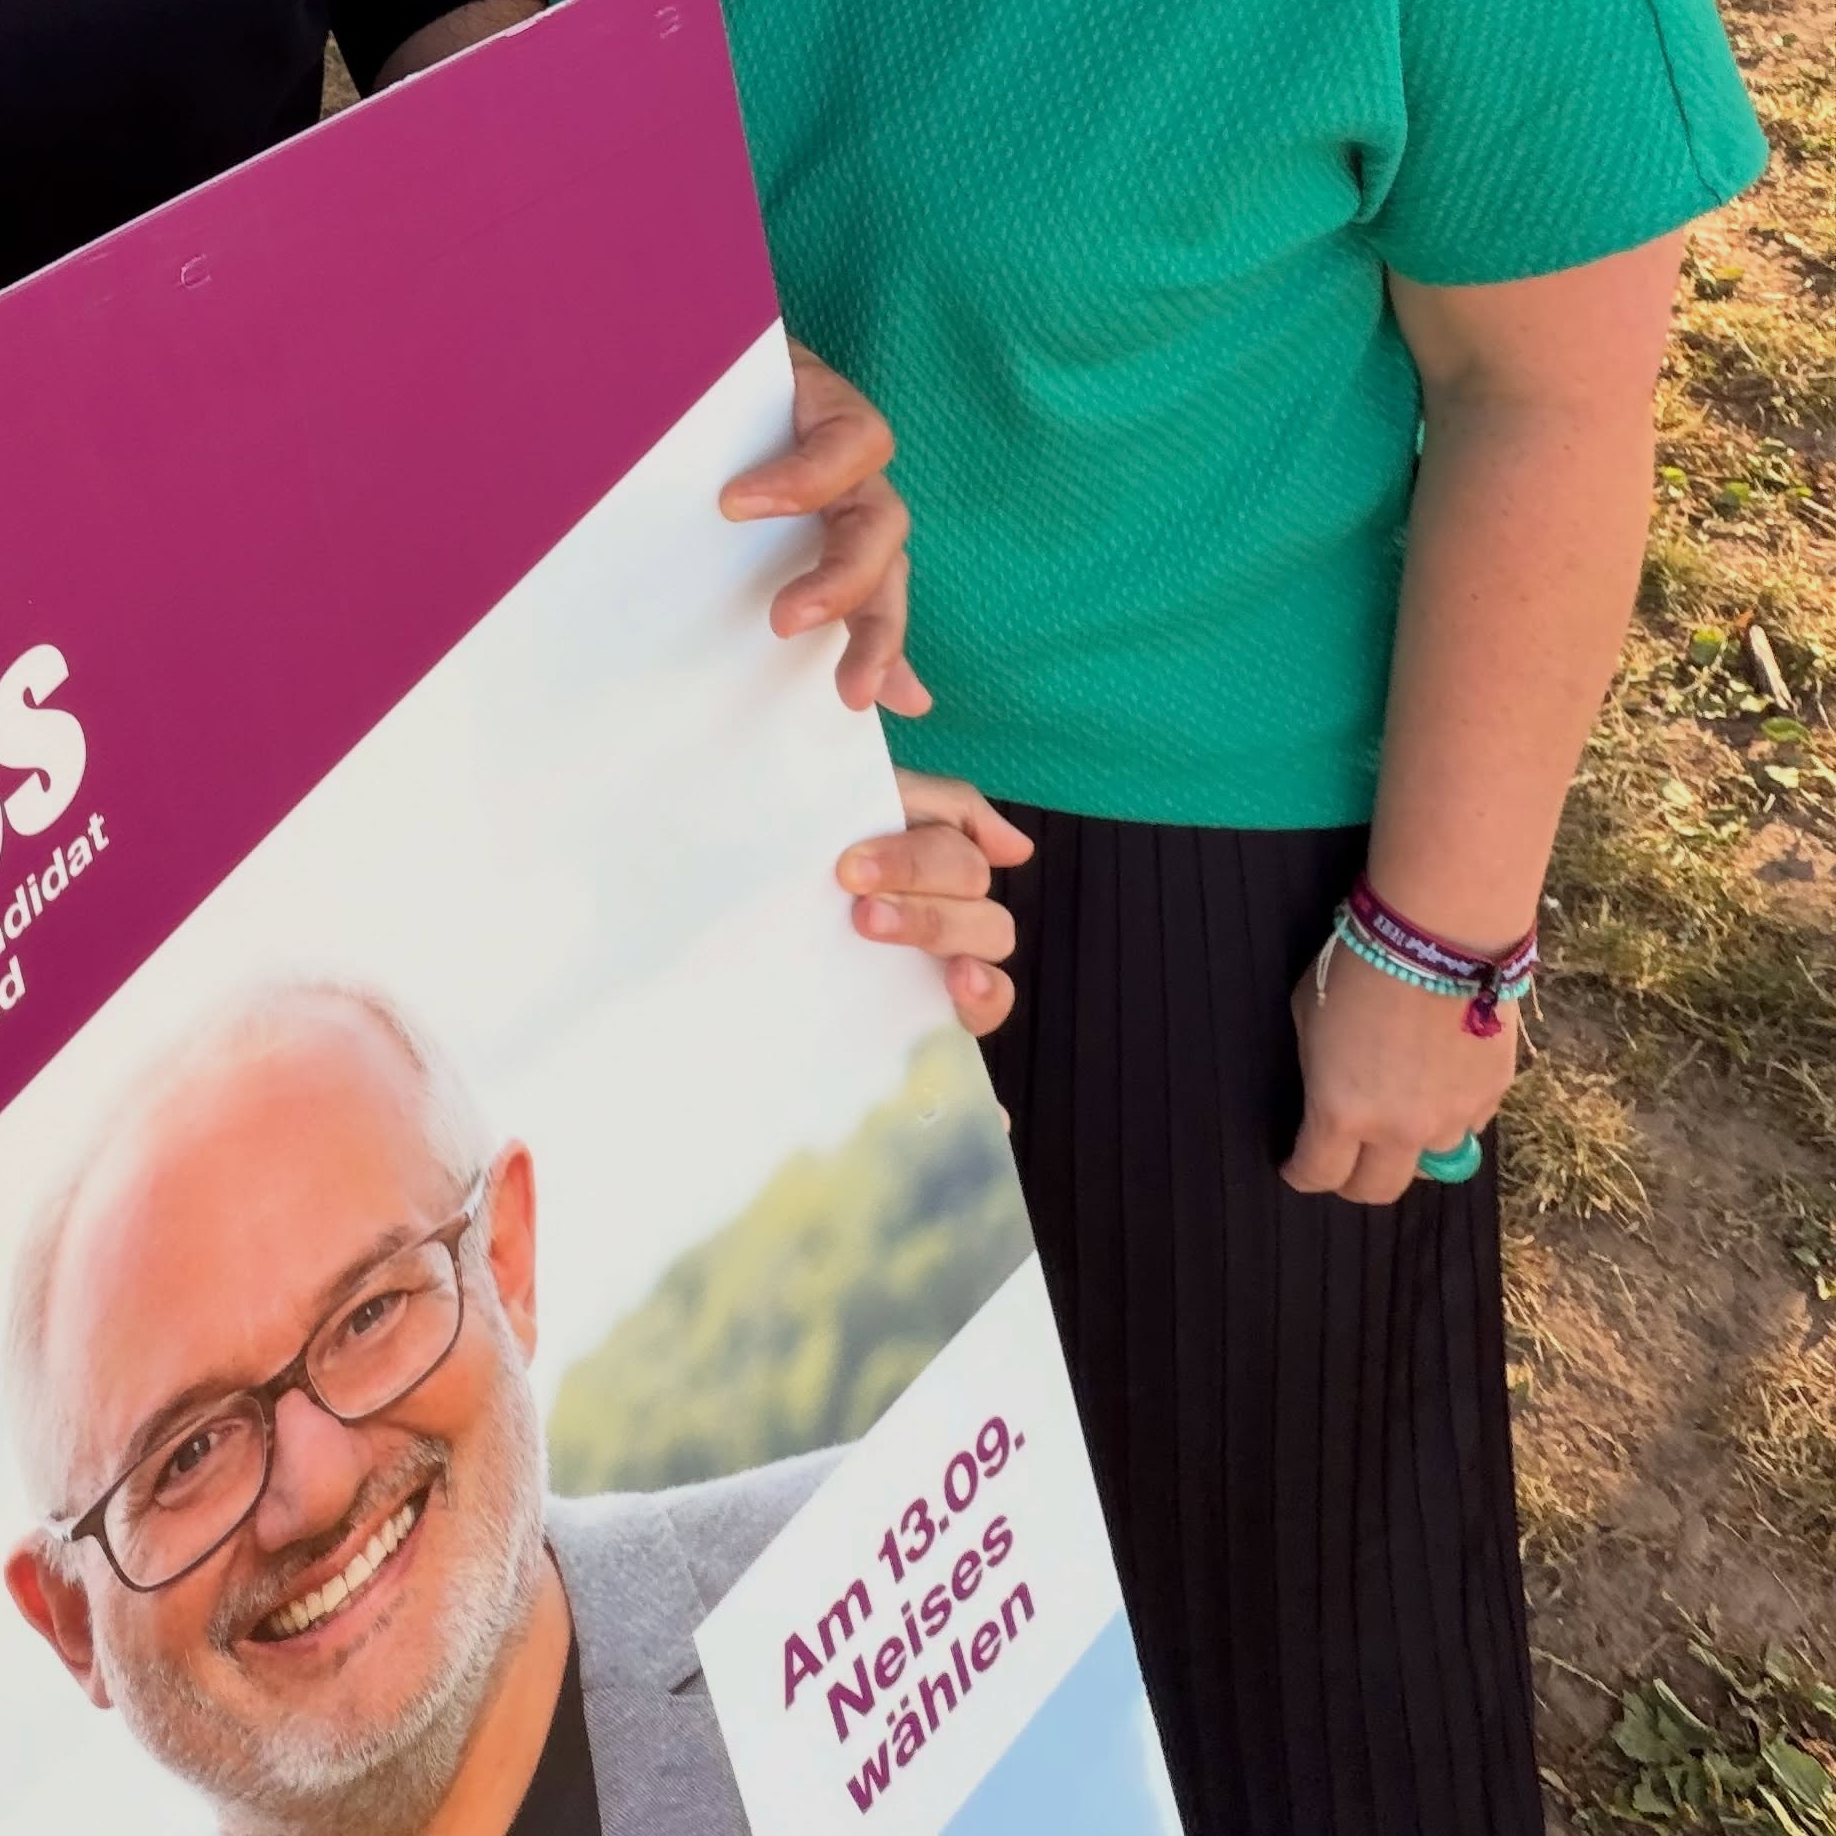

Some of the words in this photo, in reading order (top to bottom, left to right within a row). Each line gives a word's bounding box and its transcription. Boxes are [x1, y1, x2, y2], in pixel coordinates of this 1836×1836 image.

[783, 1578, 873, 1711] Am
[876, 1415, 1027, 1584] 13.09.
[826, 1514, 1014, 1744] Neises
[845, 1581, 1036, 1815] wählen
